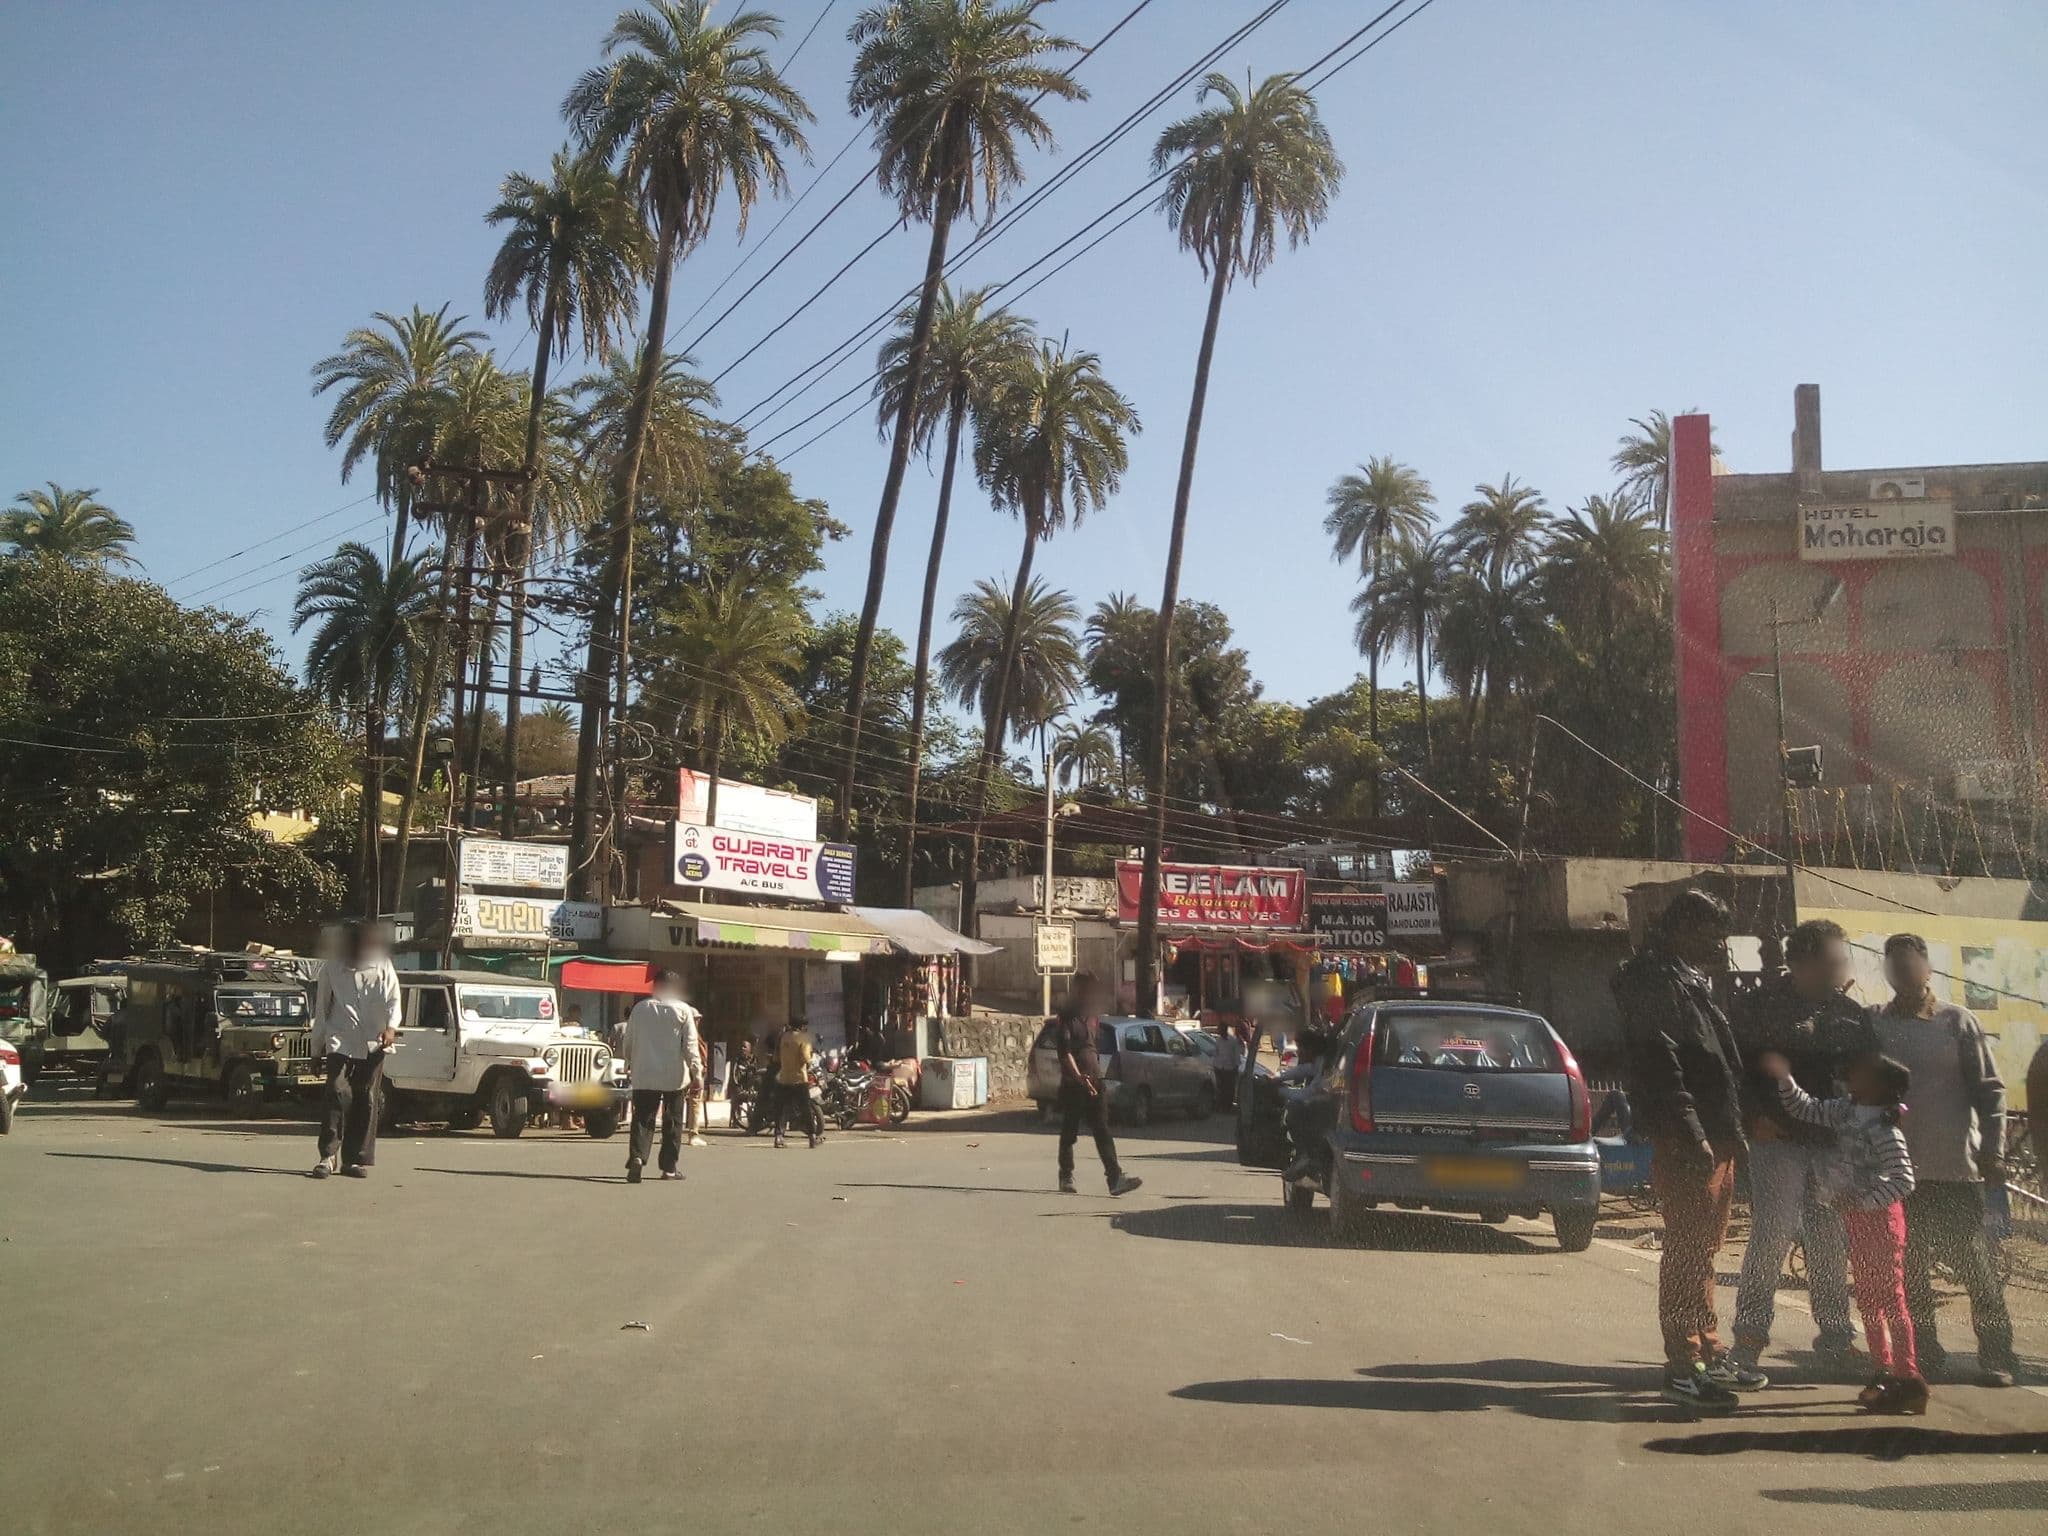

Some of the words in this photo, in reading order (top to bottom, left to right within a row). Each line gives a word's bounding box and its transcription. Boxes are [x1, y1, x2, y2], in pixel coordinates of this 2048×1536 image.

[1804, 507, 1879, 521] HOTEL
[1804, 521, 1947, 549] Maharaja
[712, 835, 813, 863] GUJARAT
[715, 855, 809, 880] TRAVELS
[740, 878, 758, 888] A/C
[761, 881, 784, 890] BUS
[1173, 894, 1256, 909] Restaurant
[1157, 907, 1181, 918] EG
[1186, 908, 1199, 919] &
[1205, 909, 1242, 920] NON
[1248, 910, 1281, 921] VEG
[1352, 914, 1375, 926] INK
[1317, 930, 1385, 946] TATTOOS
